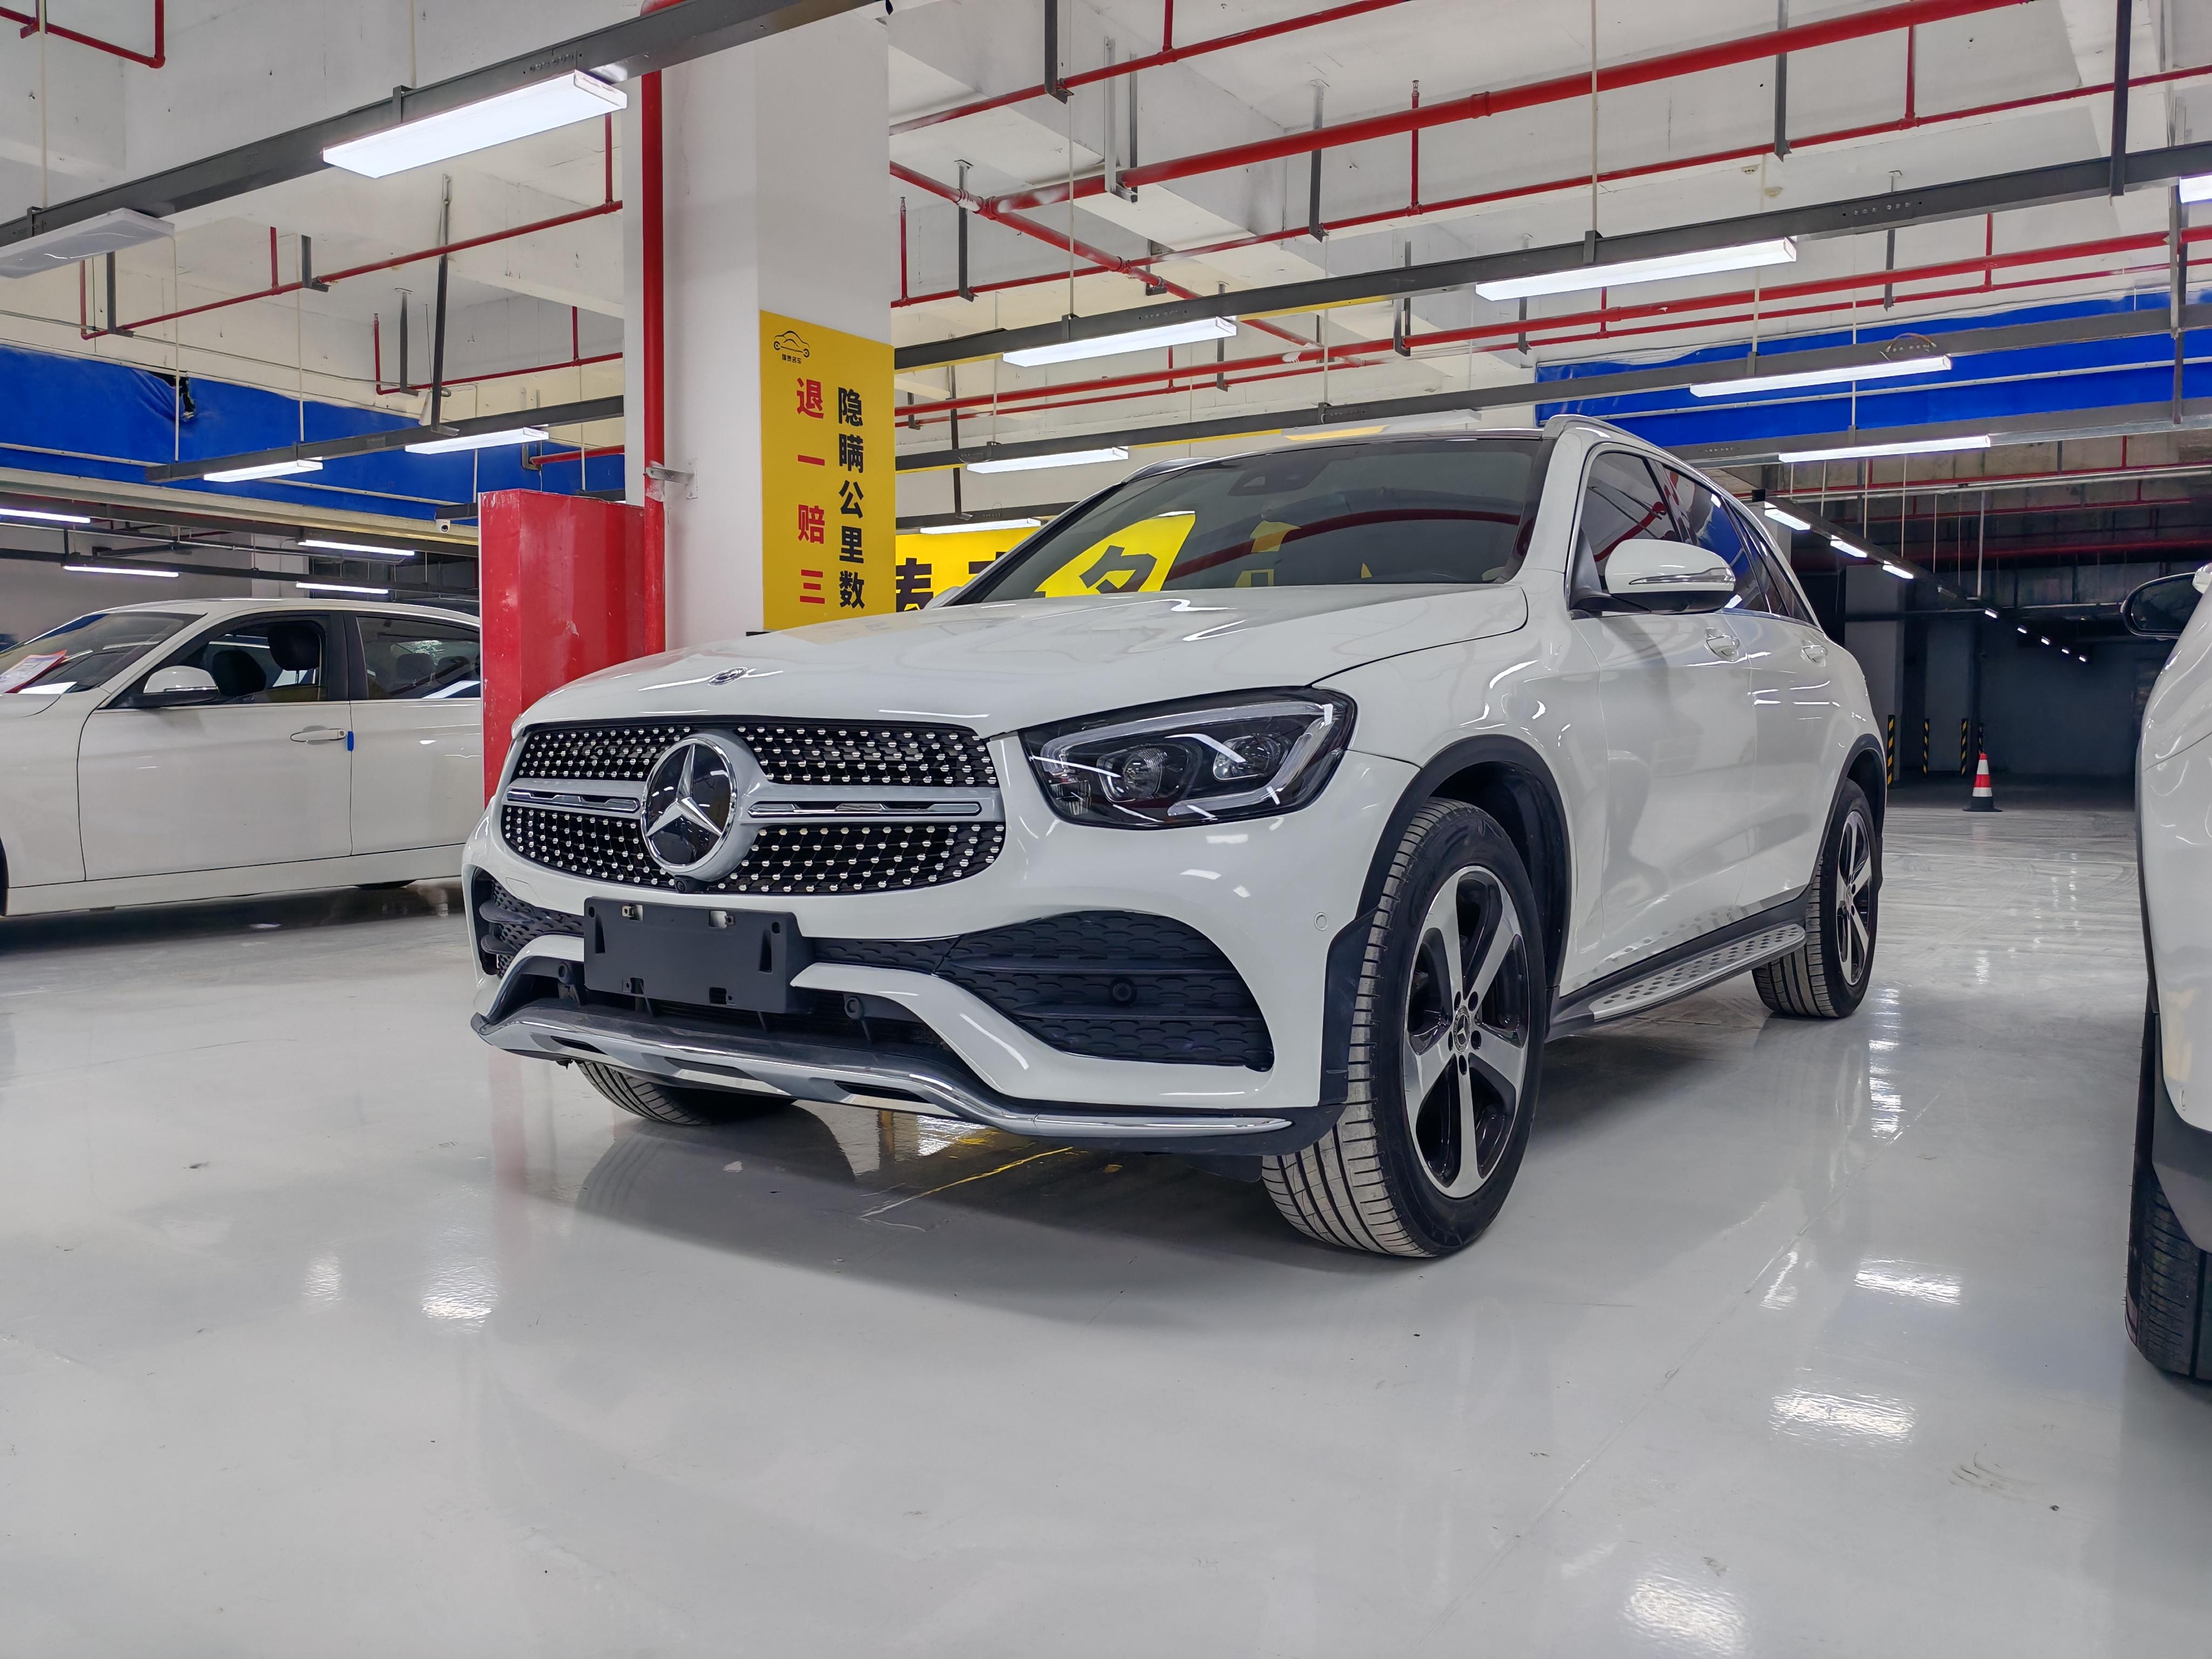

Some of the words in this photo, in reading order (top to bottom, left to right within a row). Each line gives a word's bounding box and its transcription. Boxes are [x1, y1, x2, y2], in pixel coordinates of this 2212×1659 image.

[796, 377, 826, 605] 退一赔三
[838, 386, 865, 610] 隐瞒公里数
